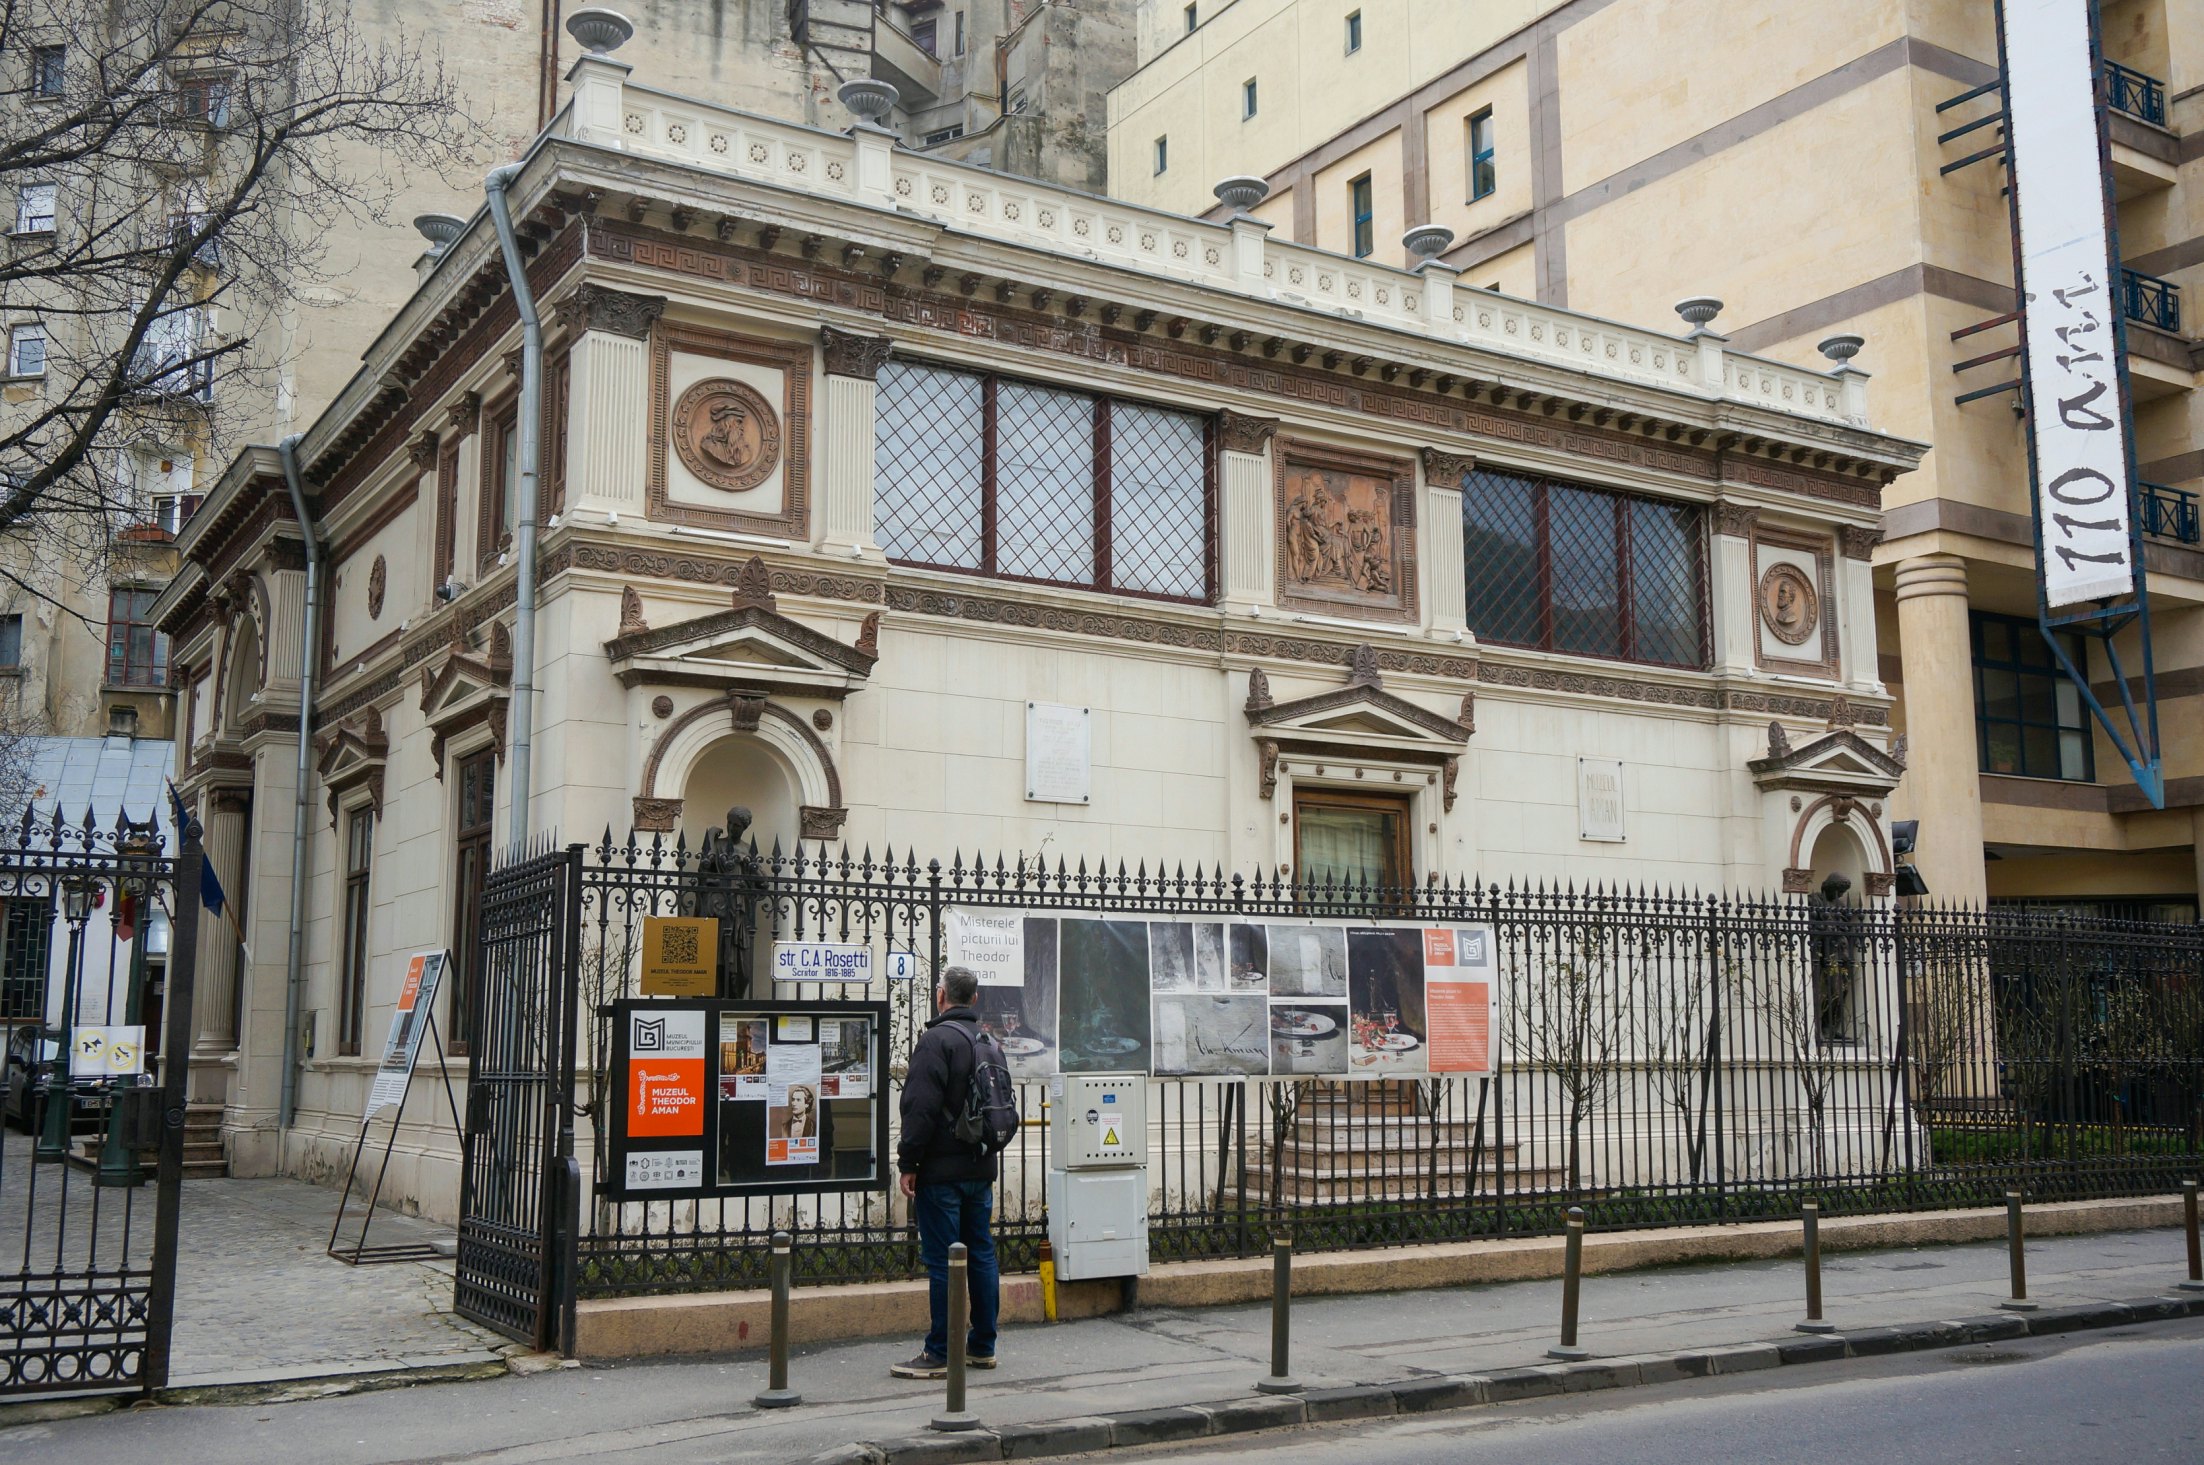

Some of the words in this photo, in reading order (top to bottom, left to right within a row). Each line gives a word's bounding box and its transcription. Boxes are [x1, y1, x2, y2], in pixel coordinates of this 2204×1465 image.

[2048, 466, 2126, 572] 110
[960, 915, 1015, 928] Misterele
[961, 933, 1001, 946] picturii
[1004, 935, 1018, 946] lui
[779, 949, 796, 967] str.
[824, 949, 868, 968] Rosetti
[960, 949, 1010, 962] Theodor
[897, 956, 905, 976] 8
[825, 968, 856, 978] 1816-1885
[972, 970, 996, 979] man
[652, 1088, 689, 1096] MUZEUL
[651, 1097, 696, 1105] THEODOR
[651, 1106, 679, 1115] AMAN
